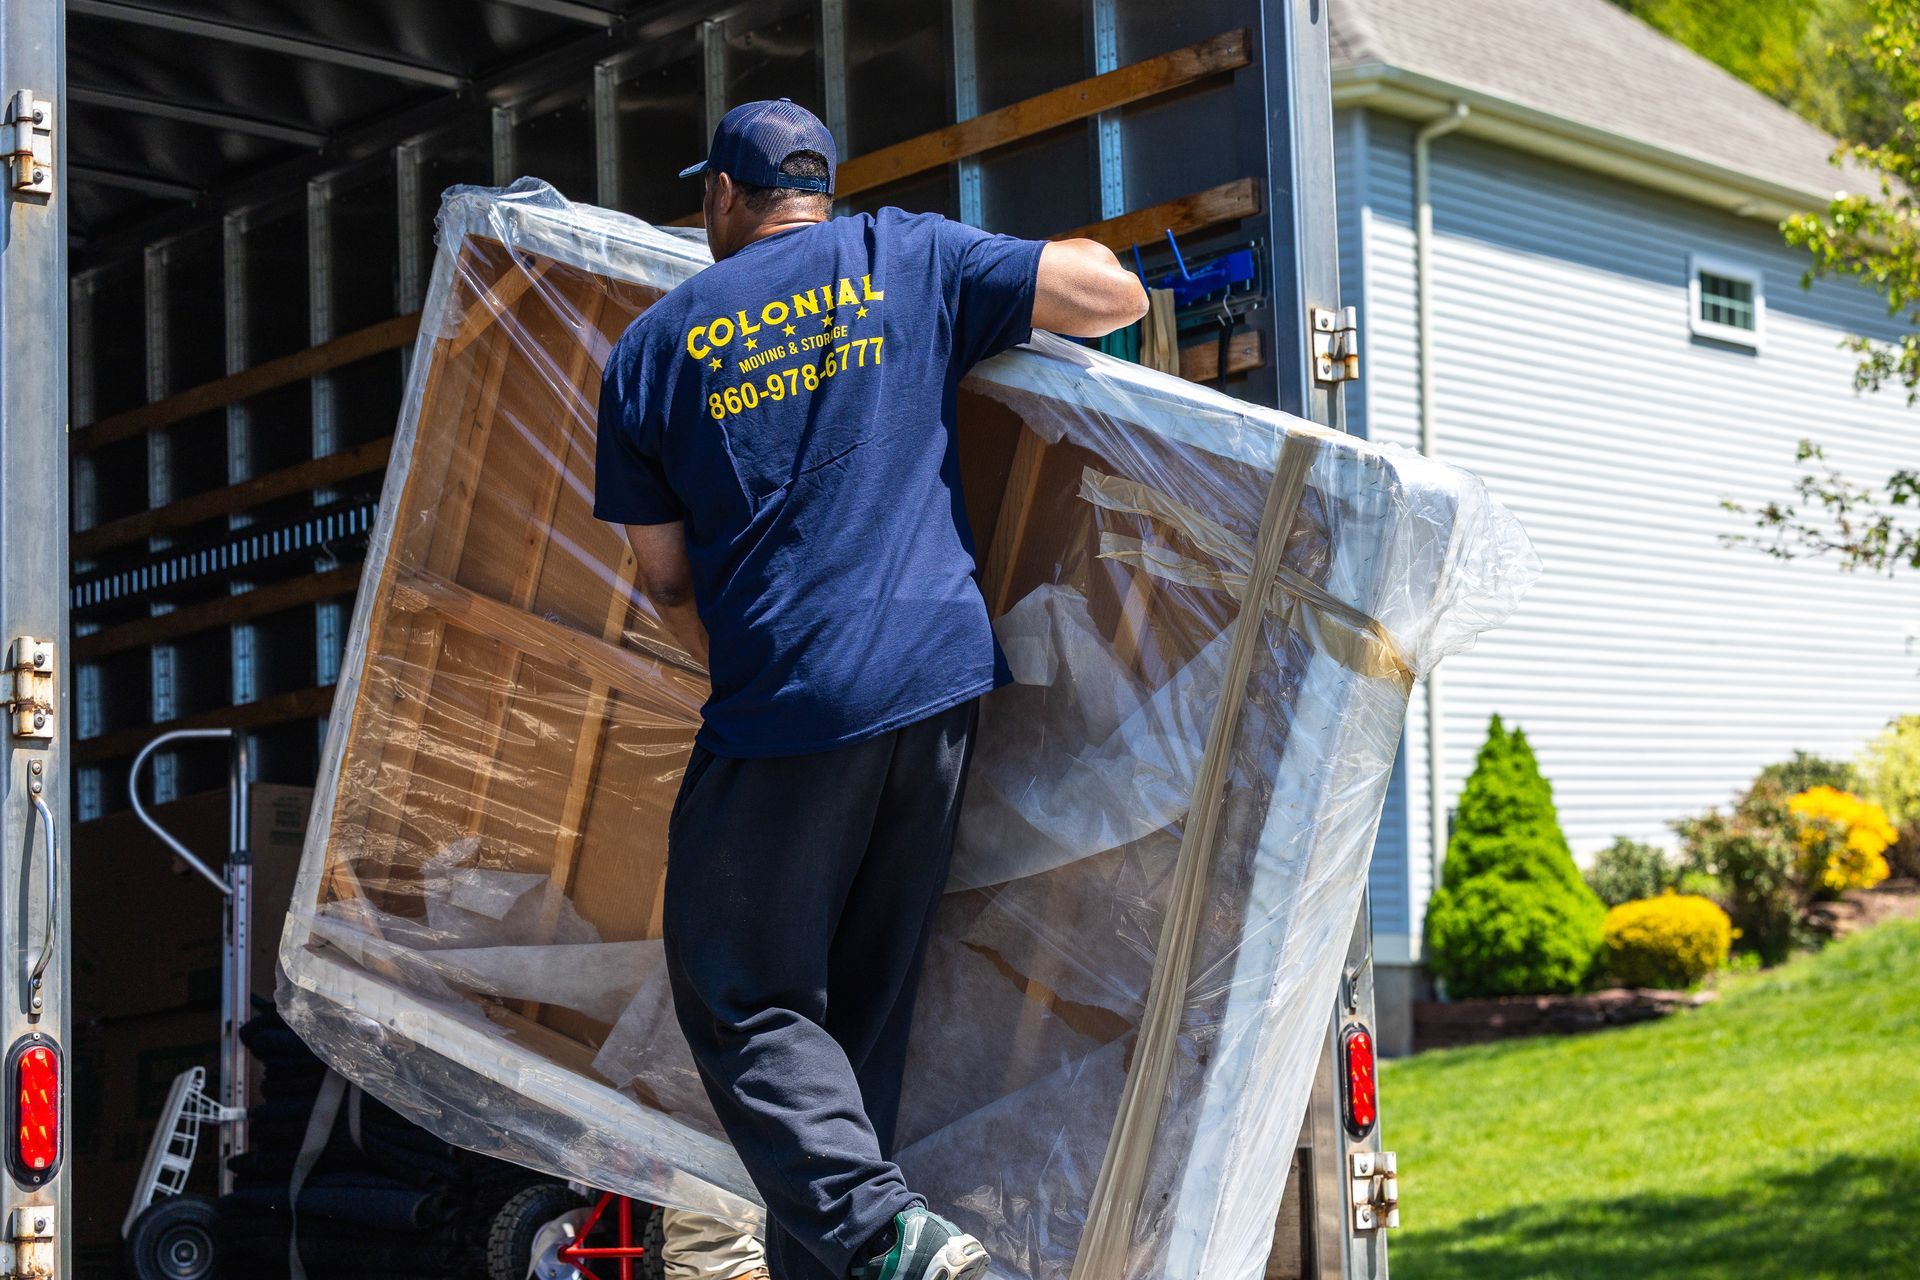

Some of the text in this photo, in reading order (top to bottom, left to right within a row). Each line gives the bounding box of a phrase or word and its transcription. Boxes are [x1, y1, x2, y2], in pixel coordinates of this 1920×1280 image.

[687, 274, 884, 359] COLONIAL
[739, 345, 786, 374] MOVING
[788, 341, 799, 355] &
[708, 336, 884, 420] 860-978-6777
